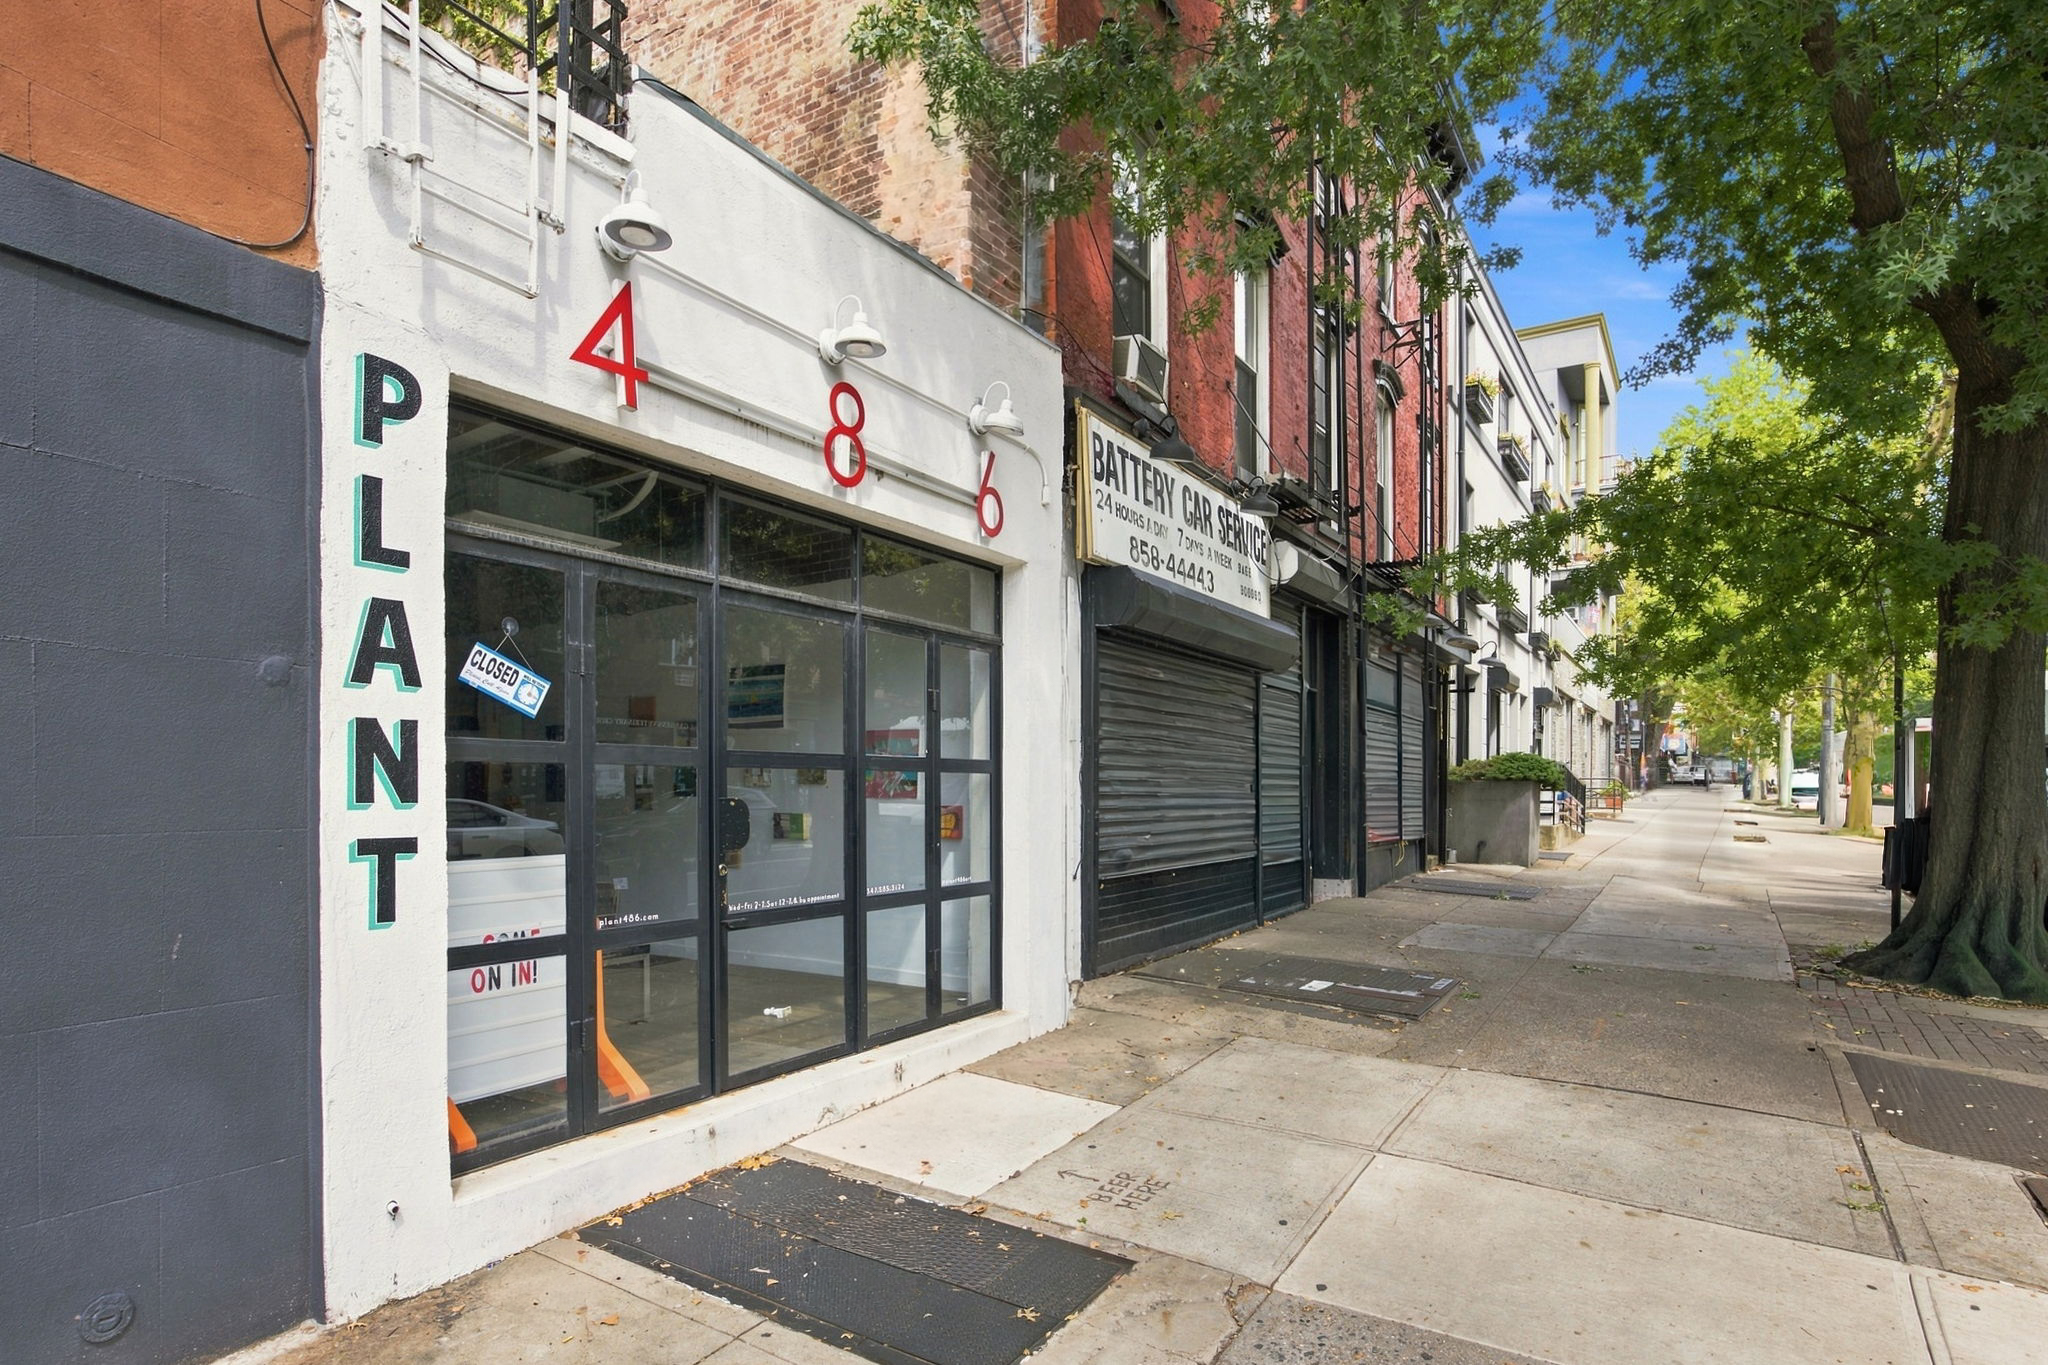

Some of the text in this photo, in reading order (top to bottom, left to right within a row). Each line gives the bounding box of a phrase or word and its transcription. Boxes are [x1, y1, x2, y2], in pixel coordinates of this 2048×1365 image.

[1093, 431, 1266, 566] BATTERY CAR SERVICE
[1095, 488, 1112, 514] 24
[1115, 501, 1145, 529] HOURS
[1177, 527, 1184, 547] 7
[1185, 536, 1204, 557] DAYS
[1213, 550, 1233, 571] WEEK
[343, 352, 423, 931] PLANT
[470, 649, 520, 687] CLOSED
[599, 913, 659, 929] plant486.com
[471, 959, 537, 994] ON IN!
[1086, 1171, 1140, 1203] BEER
[1114, 1178, 1171, 1211] HERE
